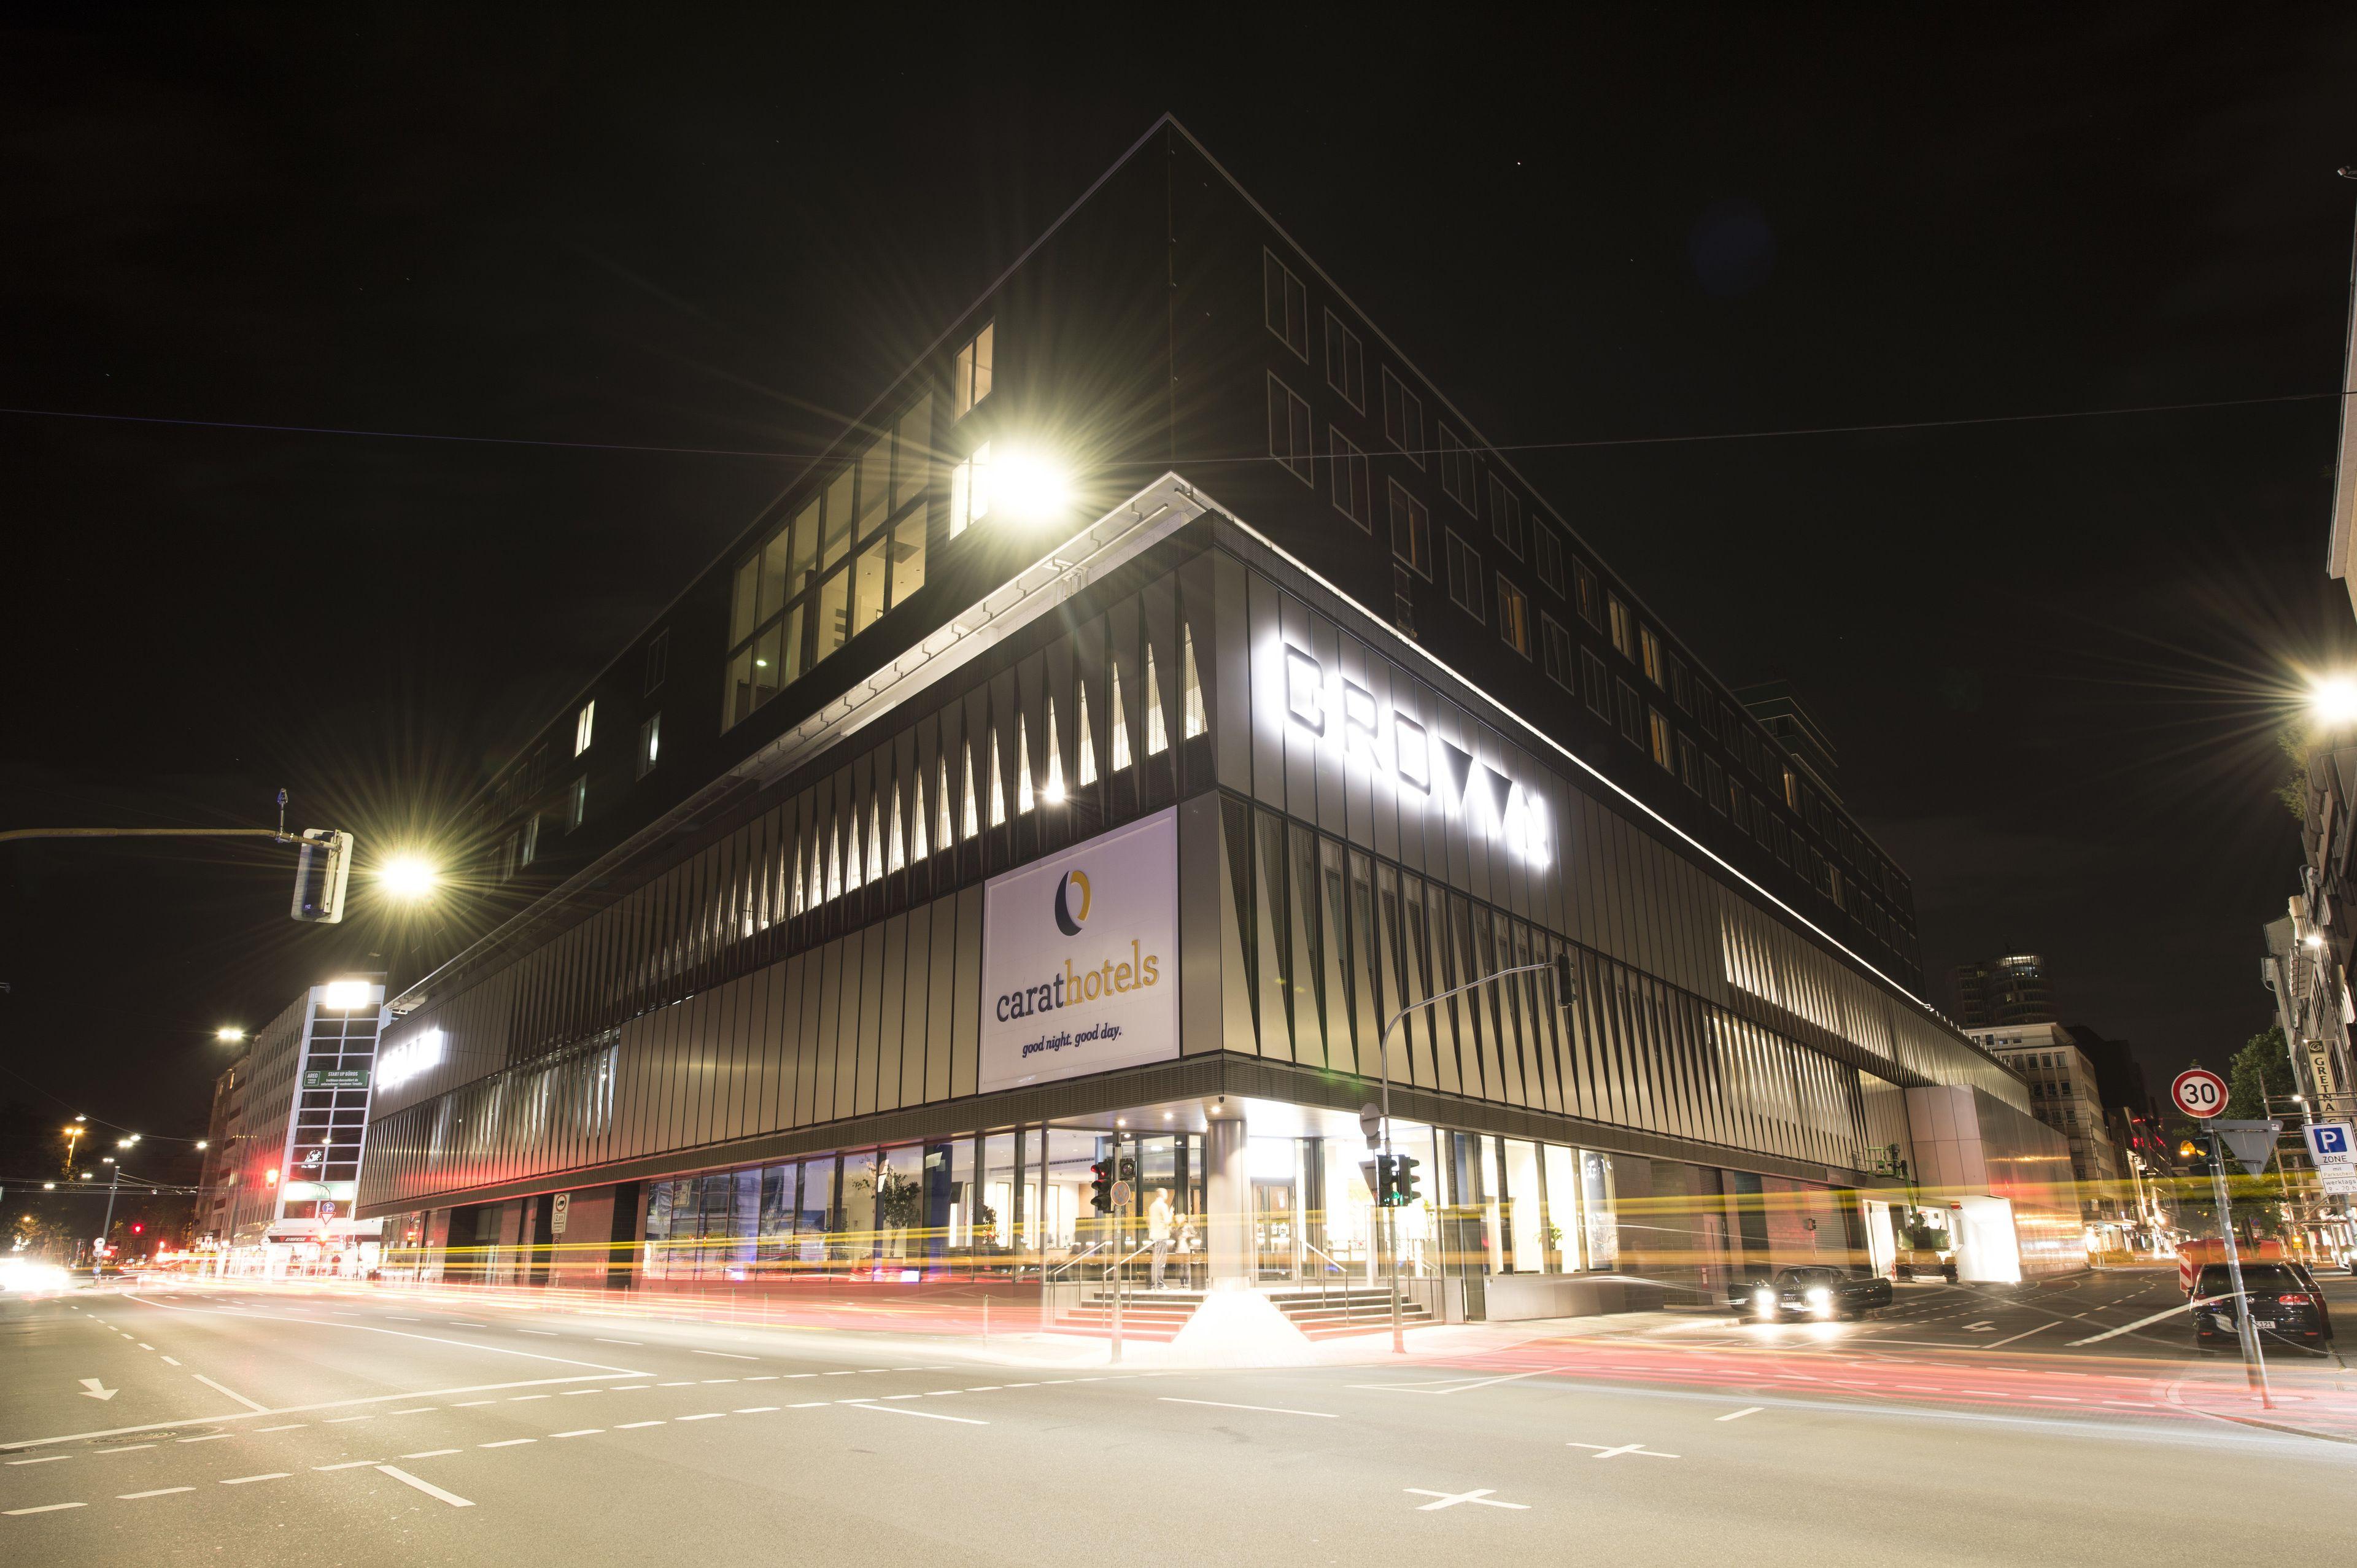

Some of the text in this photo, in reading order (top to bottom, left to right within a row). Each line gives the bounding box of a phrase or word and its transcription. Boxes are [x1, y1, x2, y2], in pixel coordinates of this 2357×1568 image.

[996, 939, 1159, 1022] carathotels
[1022, 1022, 1123, 1058] good night. good day.
[2184, 1083, 2216, 1104] 30
[2320, 1131, 2337, 1150] P
[2323, 1155, 2348, 1164] ZONE
